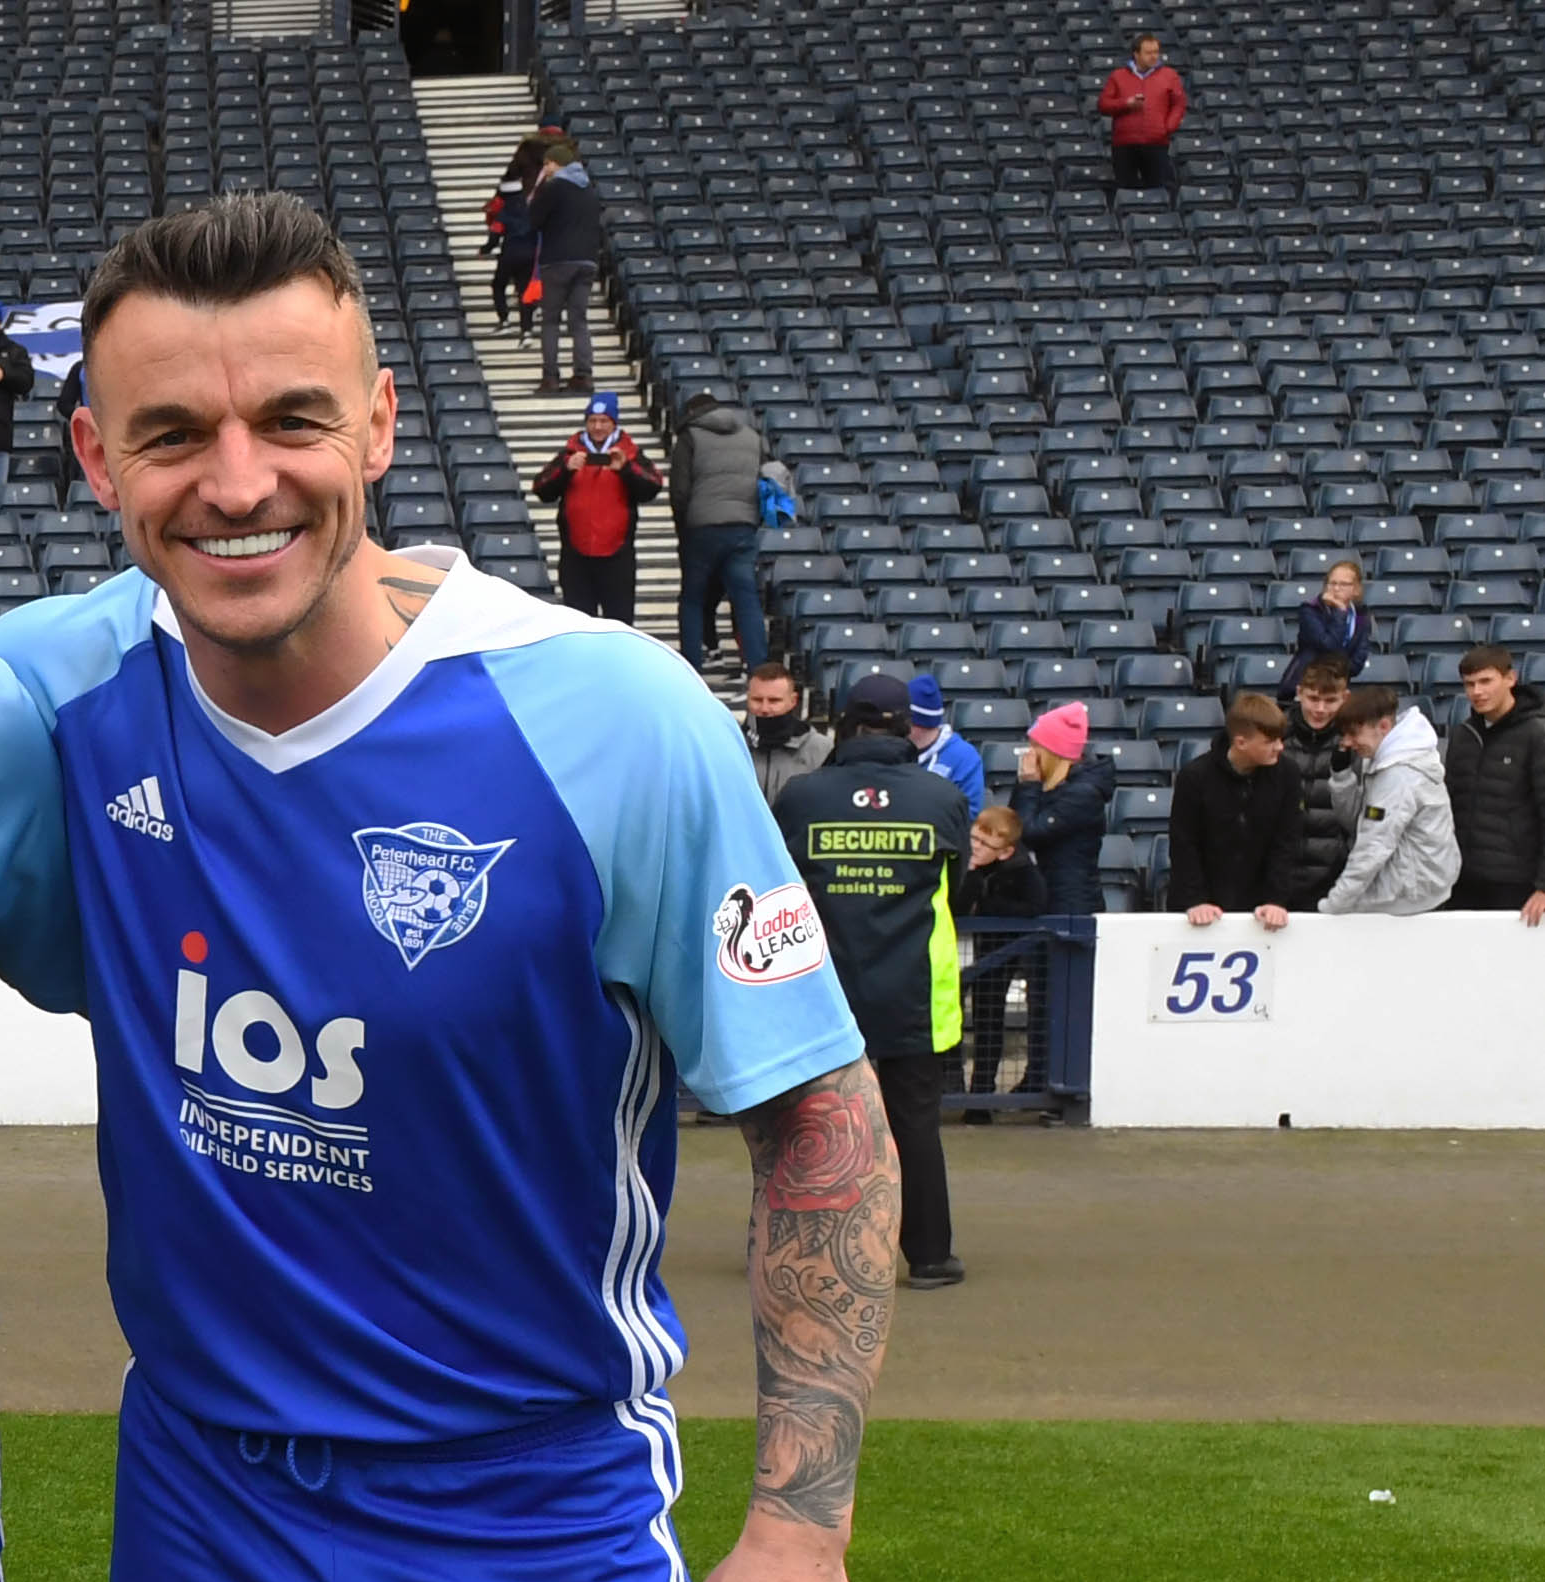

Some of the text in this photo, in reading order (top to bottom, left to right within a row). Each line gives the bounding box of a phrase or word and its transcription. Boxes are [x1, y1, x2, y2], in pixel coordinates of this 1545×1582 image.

[852, 787, 890, 809] G4S
[105, 801, 175, 843] adidas
[421, 828, 448, 842] THE
[819, 830, 923, 850] SECURITY
[370, 844, 477, 873] Peterhead F.C.
[836, 864, 894, 878] Here to
[827, 882, 906, 896] assist you
[365, 889, 388, 927] TOON
[449, 899, 478, 933] BLUE
[1166, 950, 1260, 1014] 53
[174, 931, 366, 1110] ios
[179, 1098, 370, 1170] INDEPENDENT
[264, 1158, 374, 1193] SERVICES
